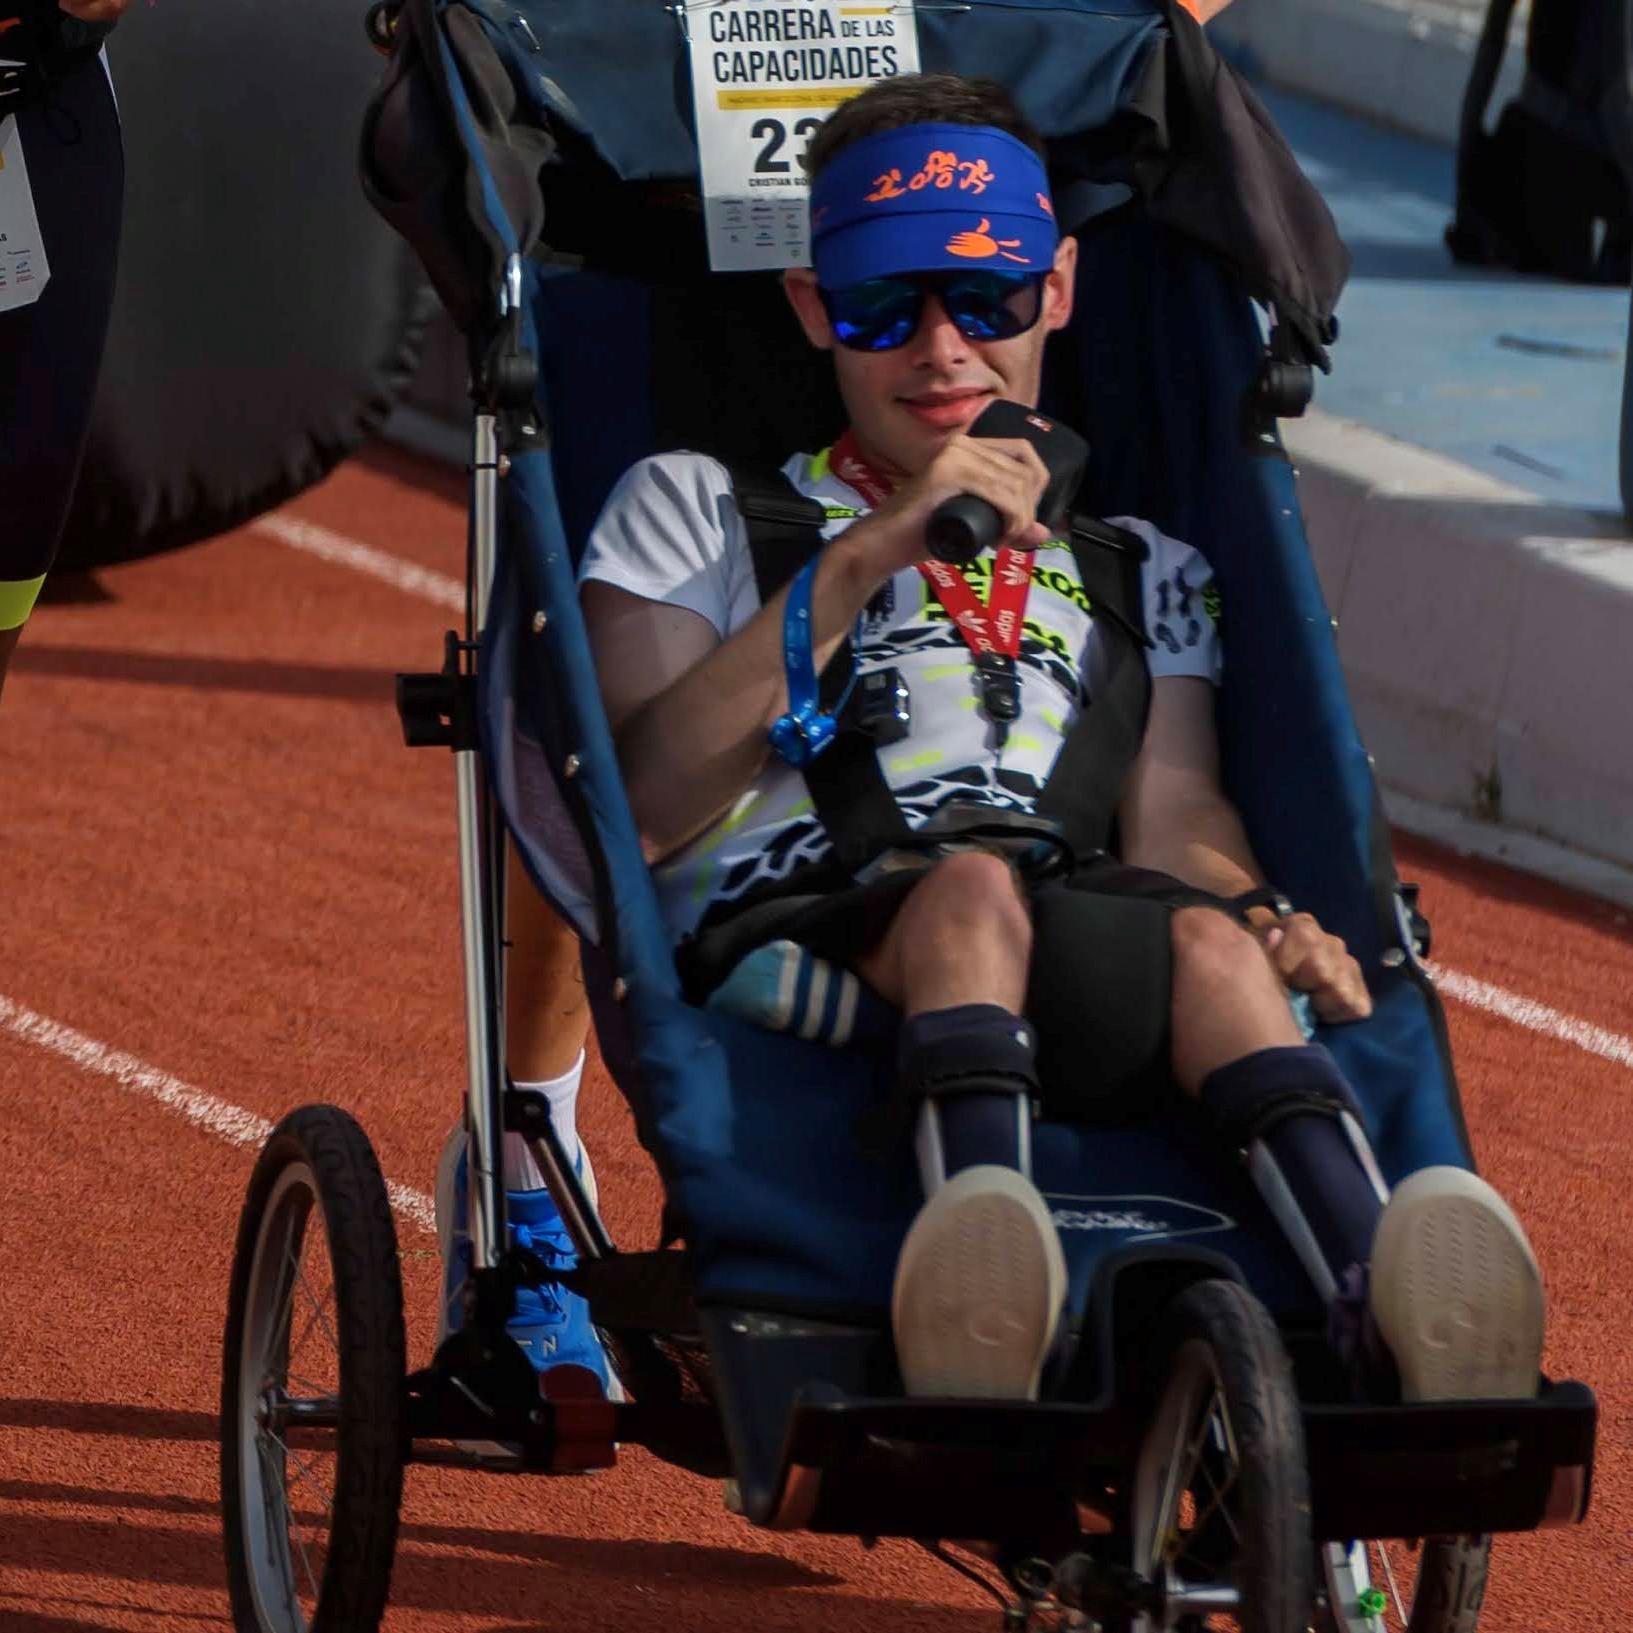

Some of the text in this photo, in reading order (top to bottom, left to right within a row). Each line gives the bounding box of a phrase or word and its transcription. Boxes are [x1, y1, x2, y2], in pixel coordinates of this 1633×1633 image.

[710, 8, 895, 43] CARRERA DE LAS
[713, 45, 898, 84] CAPACIDADES
[751, 117, 824, 174] 23
